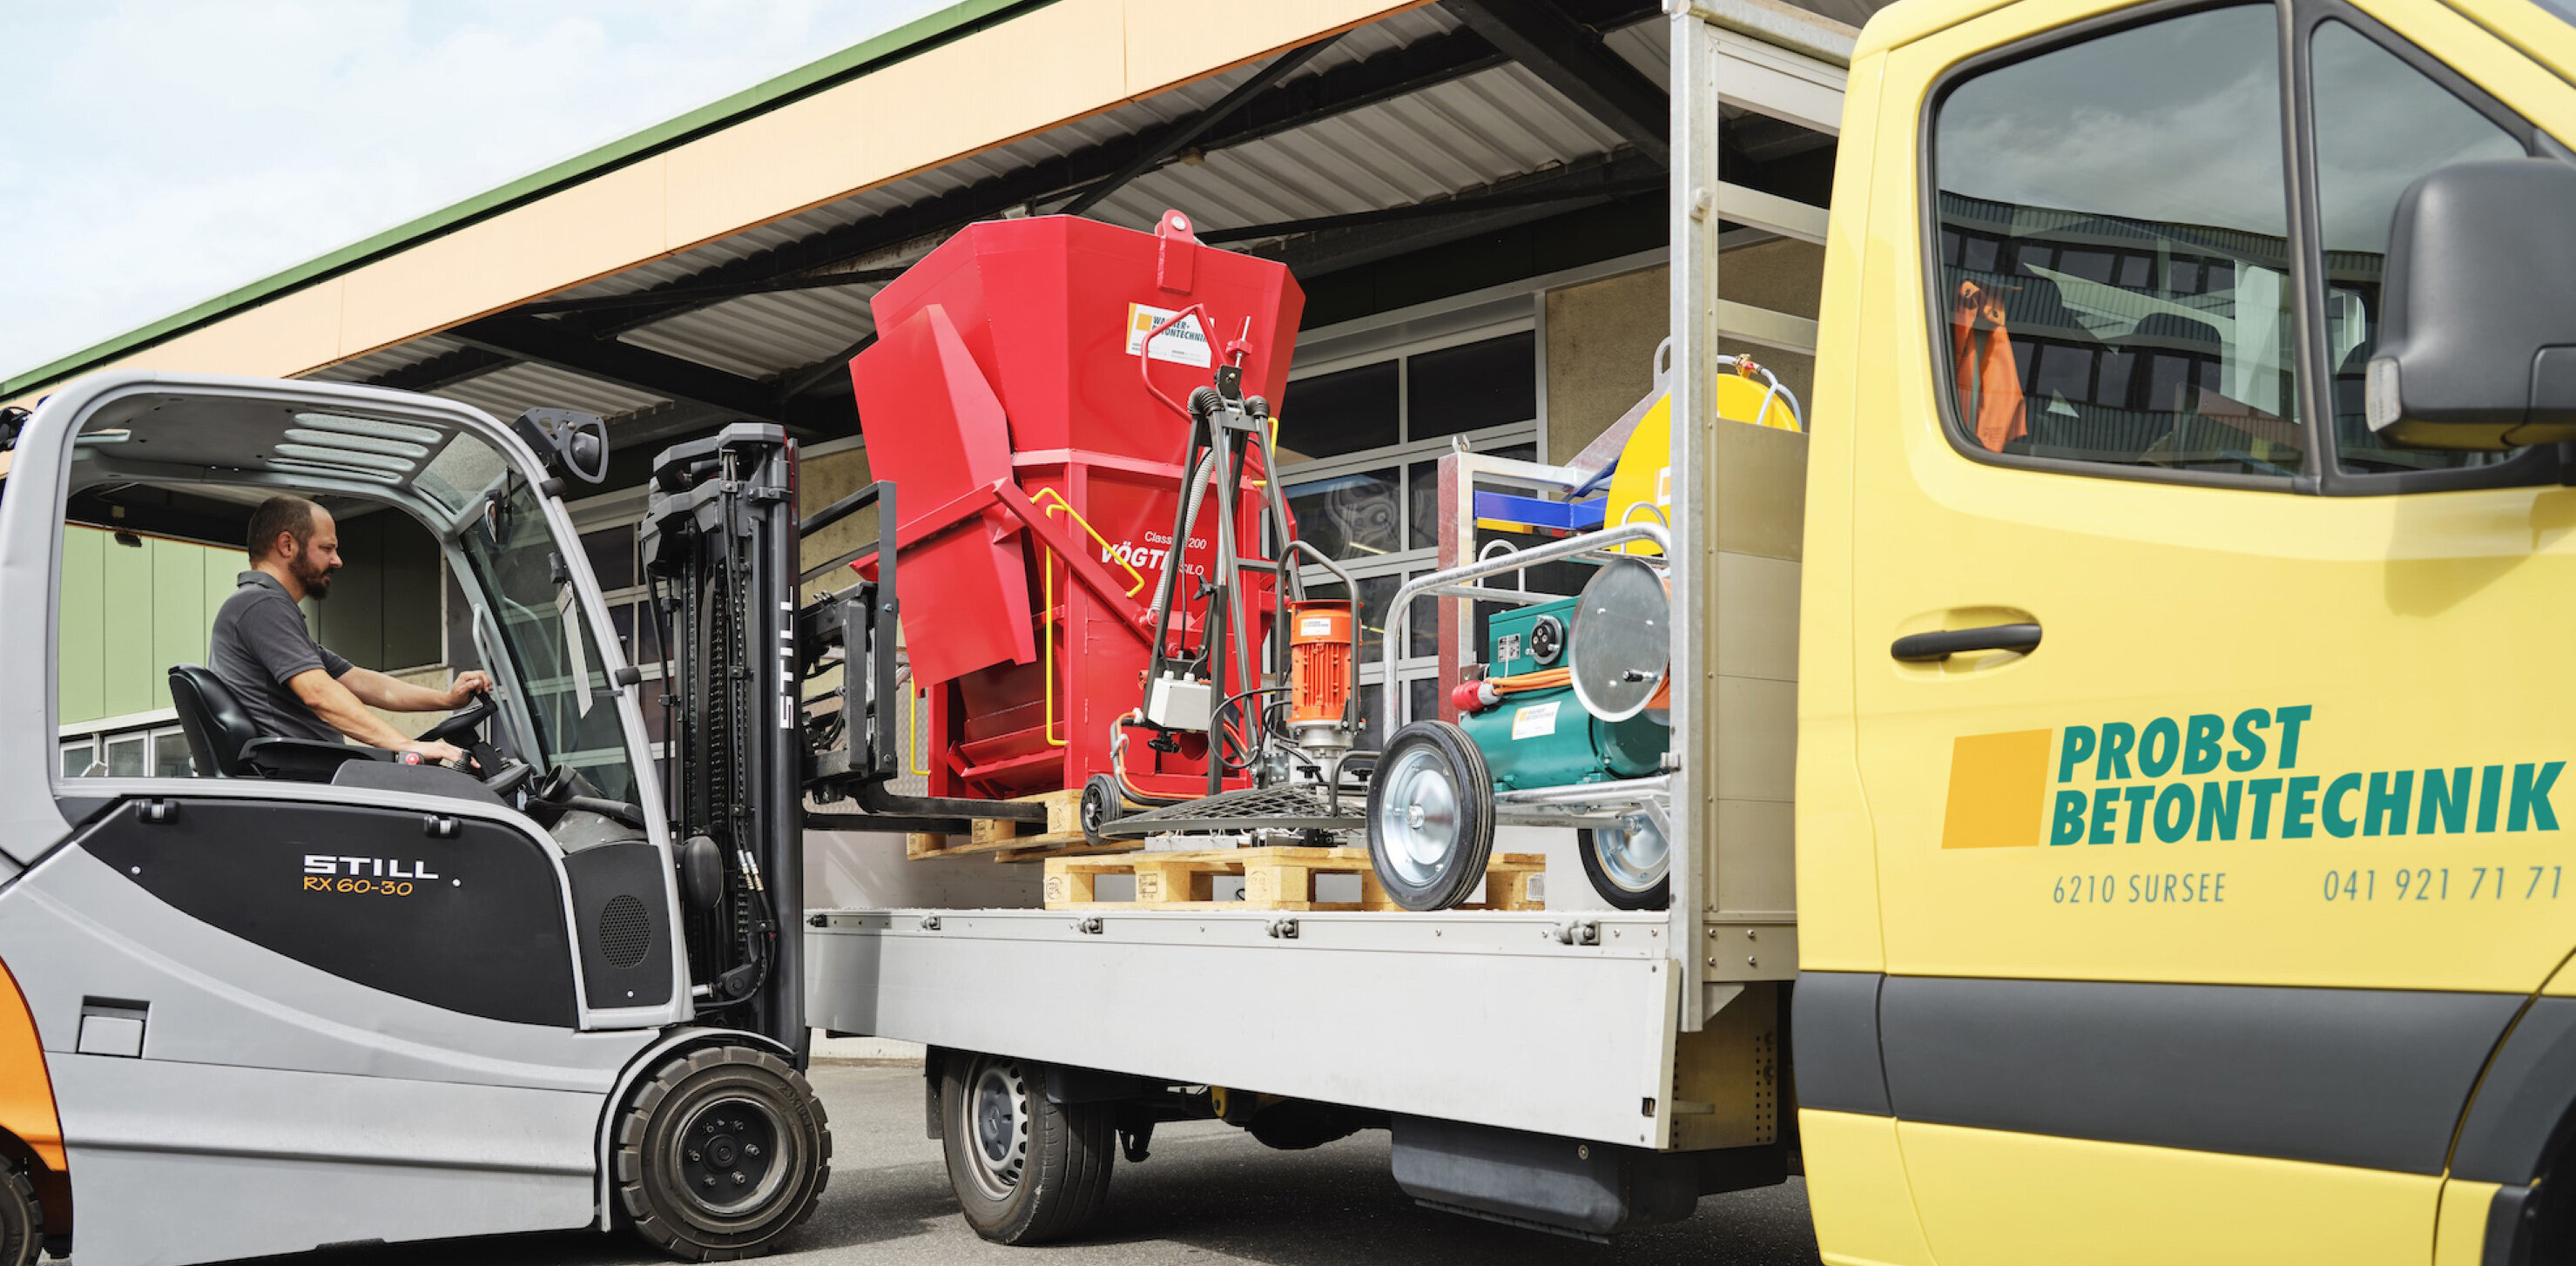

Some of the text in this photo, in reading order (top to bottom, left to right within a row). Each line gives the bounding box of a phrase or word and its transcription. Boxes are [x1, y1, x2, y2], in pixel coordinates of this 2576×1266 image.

[1151, 324, 1208, 343] ONTECHNI
[1152, 315, 1190, 329] WAER-
[1144, 530, 1207, 549] Class 200
[779, 585, 794, 730] STILL
[2057, 704, 2313, 784] PROBST
[2049, 760, 2567, 846] BETONTECHNIK
[303, 854, 439, 879] STILL
[303, 875, 414, 897] RX 60-30
[2053, 865, 2562, 904] 6210 SURSEE 041 921 71 71
